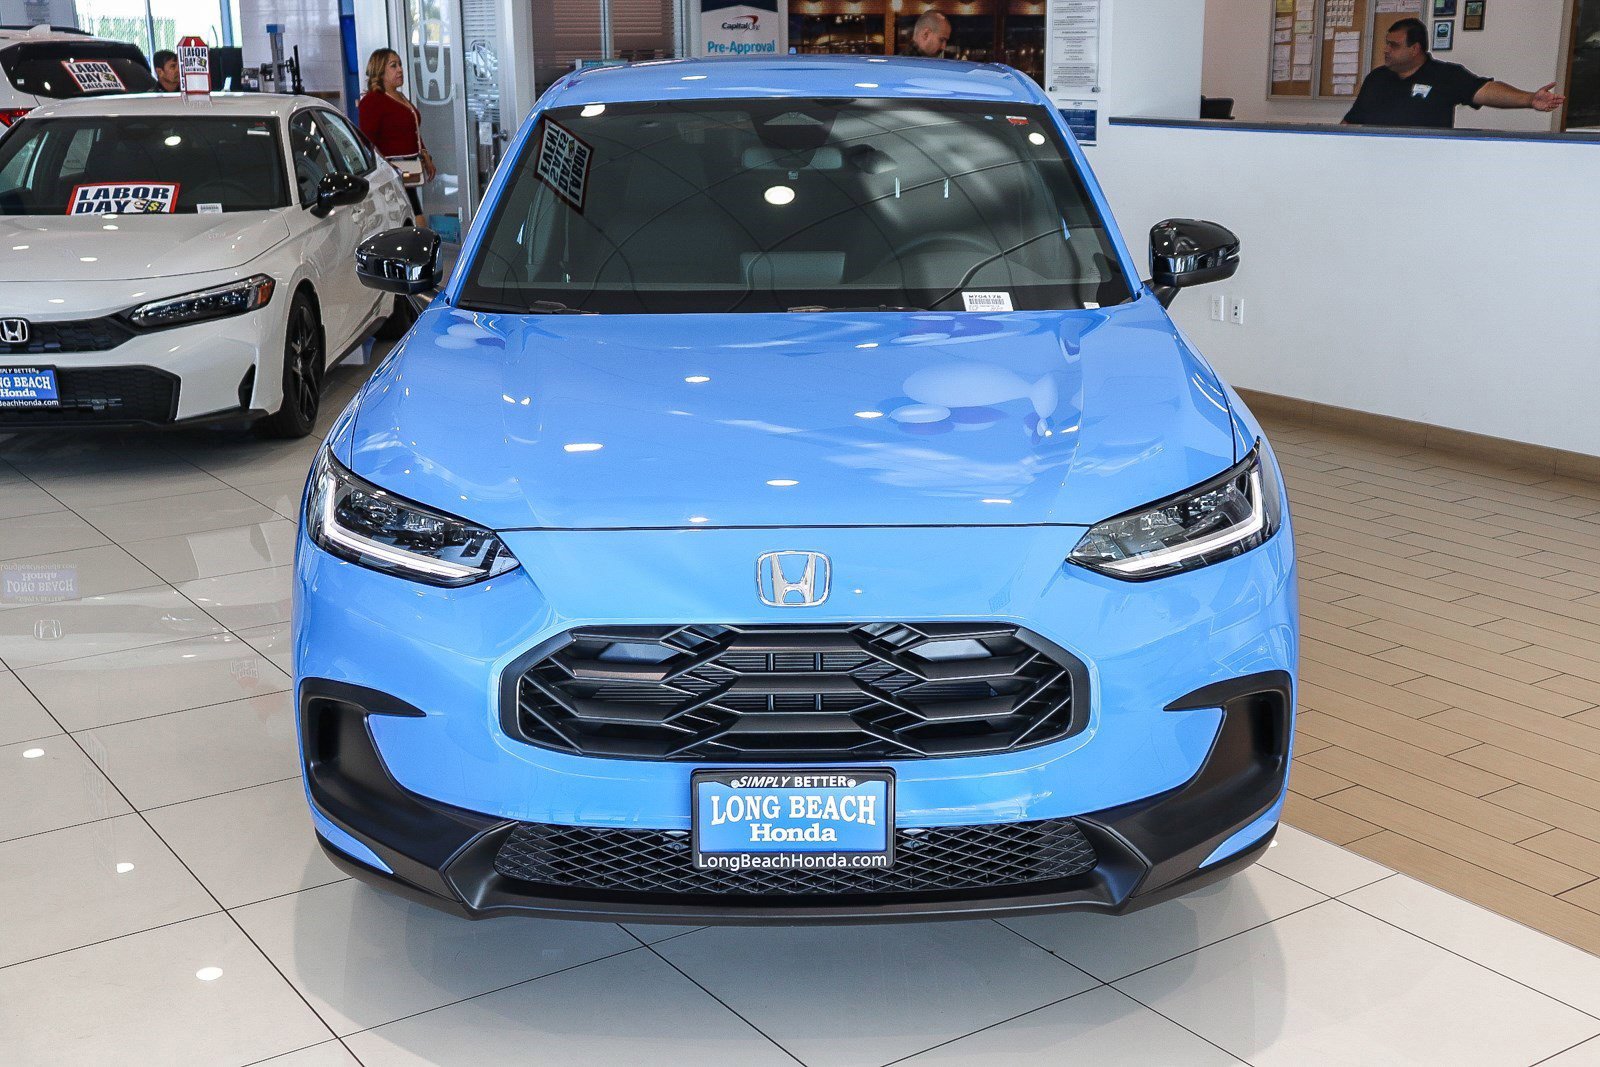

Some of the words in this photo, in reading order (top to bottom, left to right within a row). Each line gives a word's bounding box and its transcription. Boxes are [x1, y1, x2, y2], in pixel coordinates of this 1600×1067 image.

[721, 22, 748, 31] Capital
[184, 47, 208, 57] LABOR
[707, 40, 776, 54] Pre-Approval
[68, 62, 112, 73] LABOR
[184, 57, 196, 67] DAY
[75, 72, 103, 84] DAY
[81, 82, 103, 90] SALES
[79, 187, 170, 201] LABOR
[75, 199, 131, 214] DAY
[13, 376, 51, 390] BEACH
[0, 388, 37, 398] Honda
[737, 776, 791, 788] SIMPLY
[794, 776, 847, 788] BETTER
[710, 795, 781, 826] LONG
[788, 795, 877, 826] BEACH
[749, 822, 838, 842] Honda
[698, 853, 887, 871] LongBeachHonda.com
